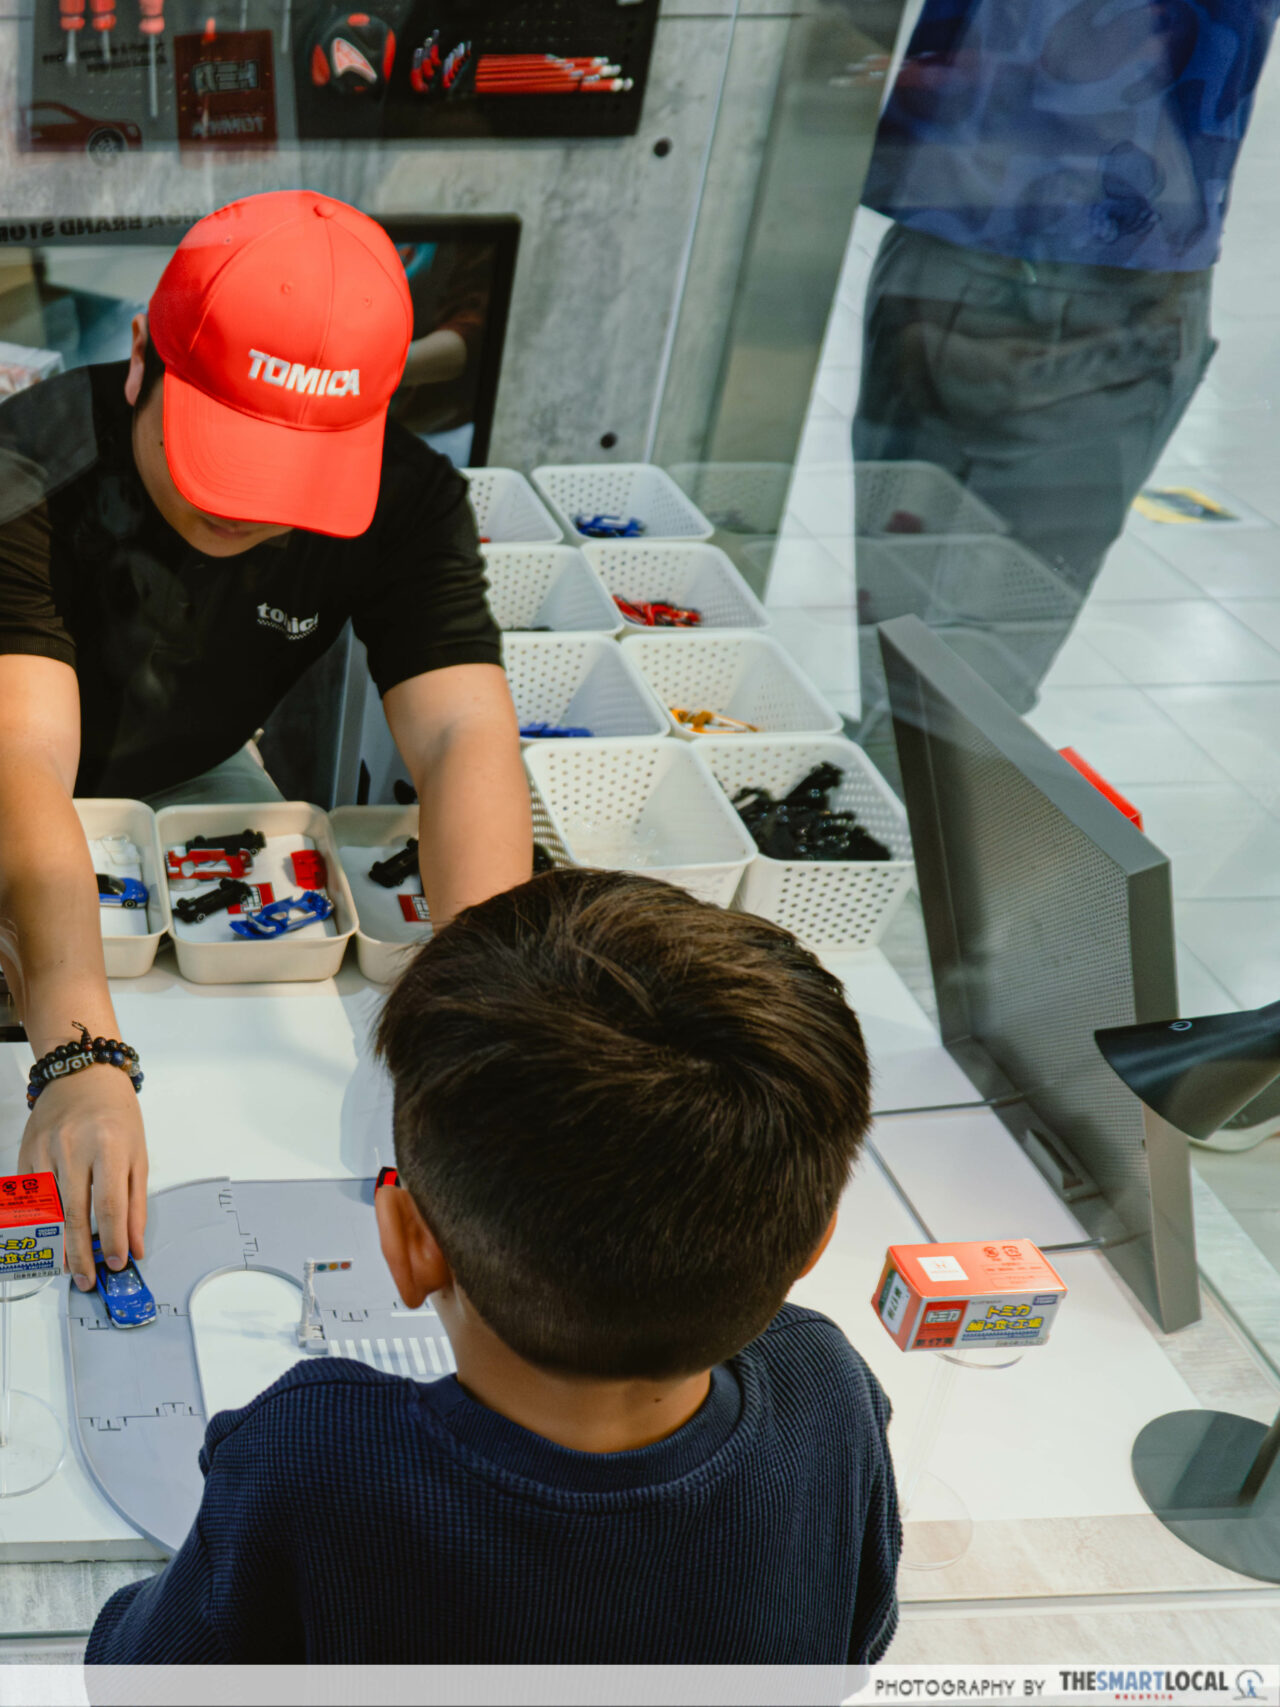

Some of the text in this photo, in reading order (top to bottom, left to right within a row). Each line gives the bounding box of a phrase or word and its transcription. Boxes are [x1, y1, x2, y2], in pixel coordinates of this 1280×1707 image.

[247, 348, 361, 397] TOMICA
[986, 1304, 1032, 1319] トミカ
